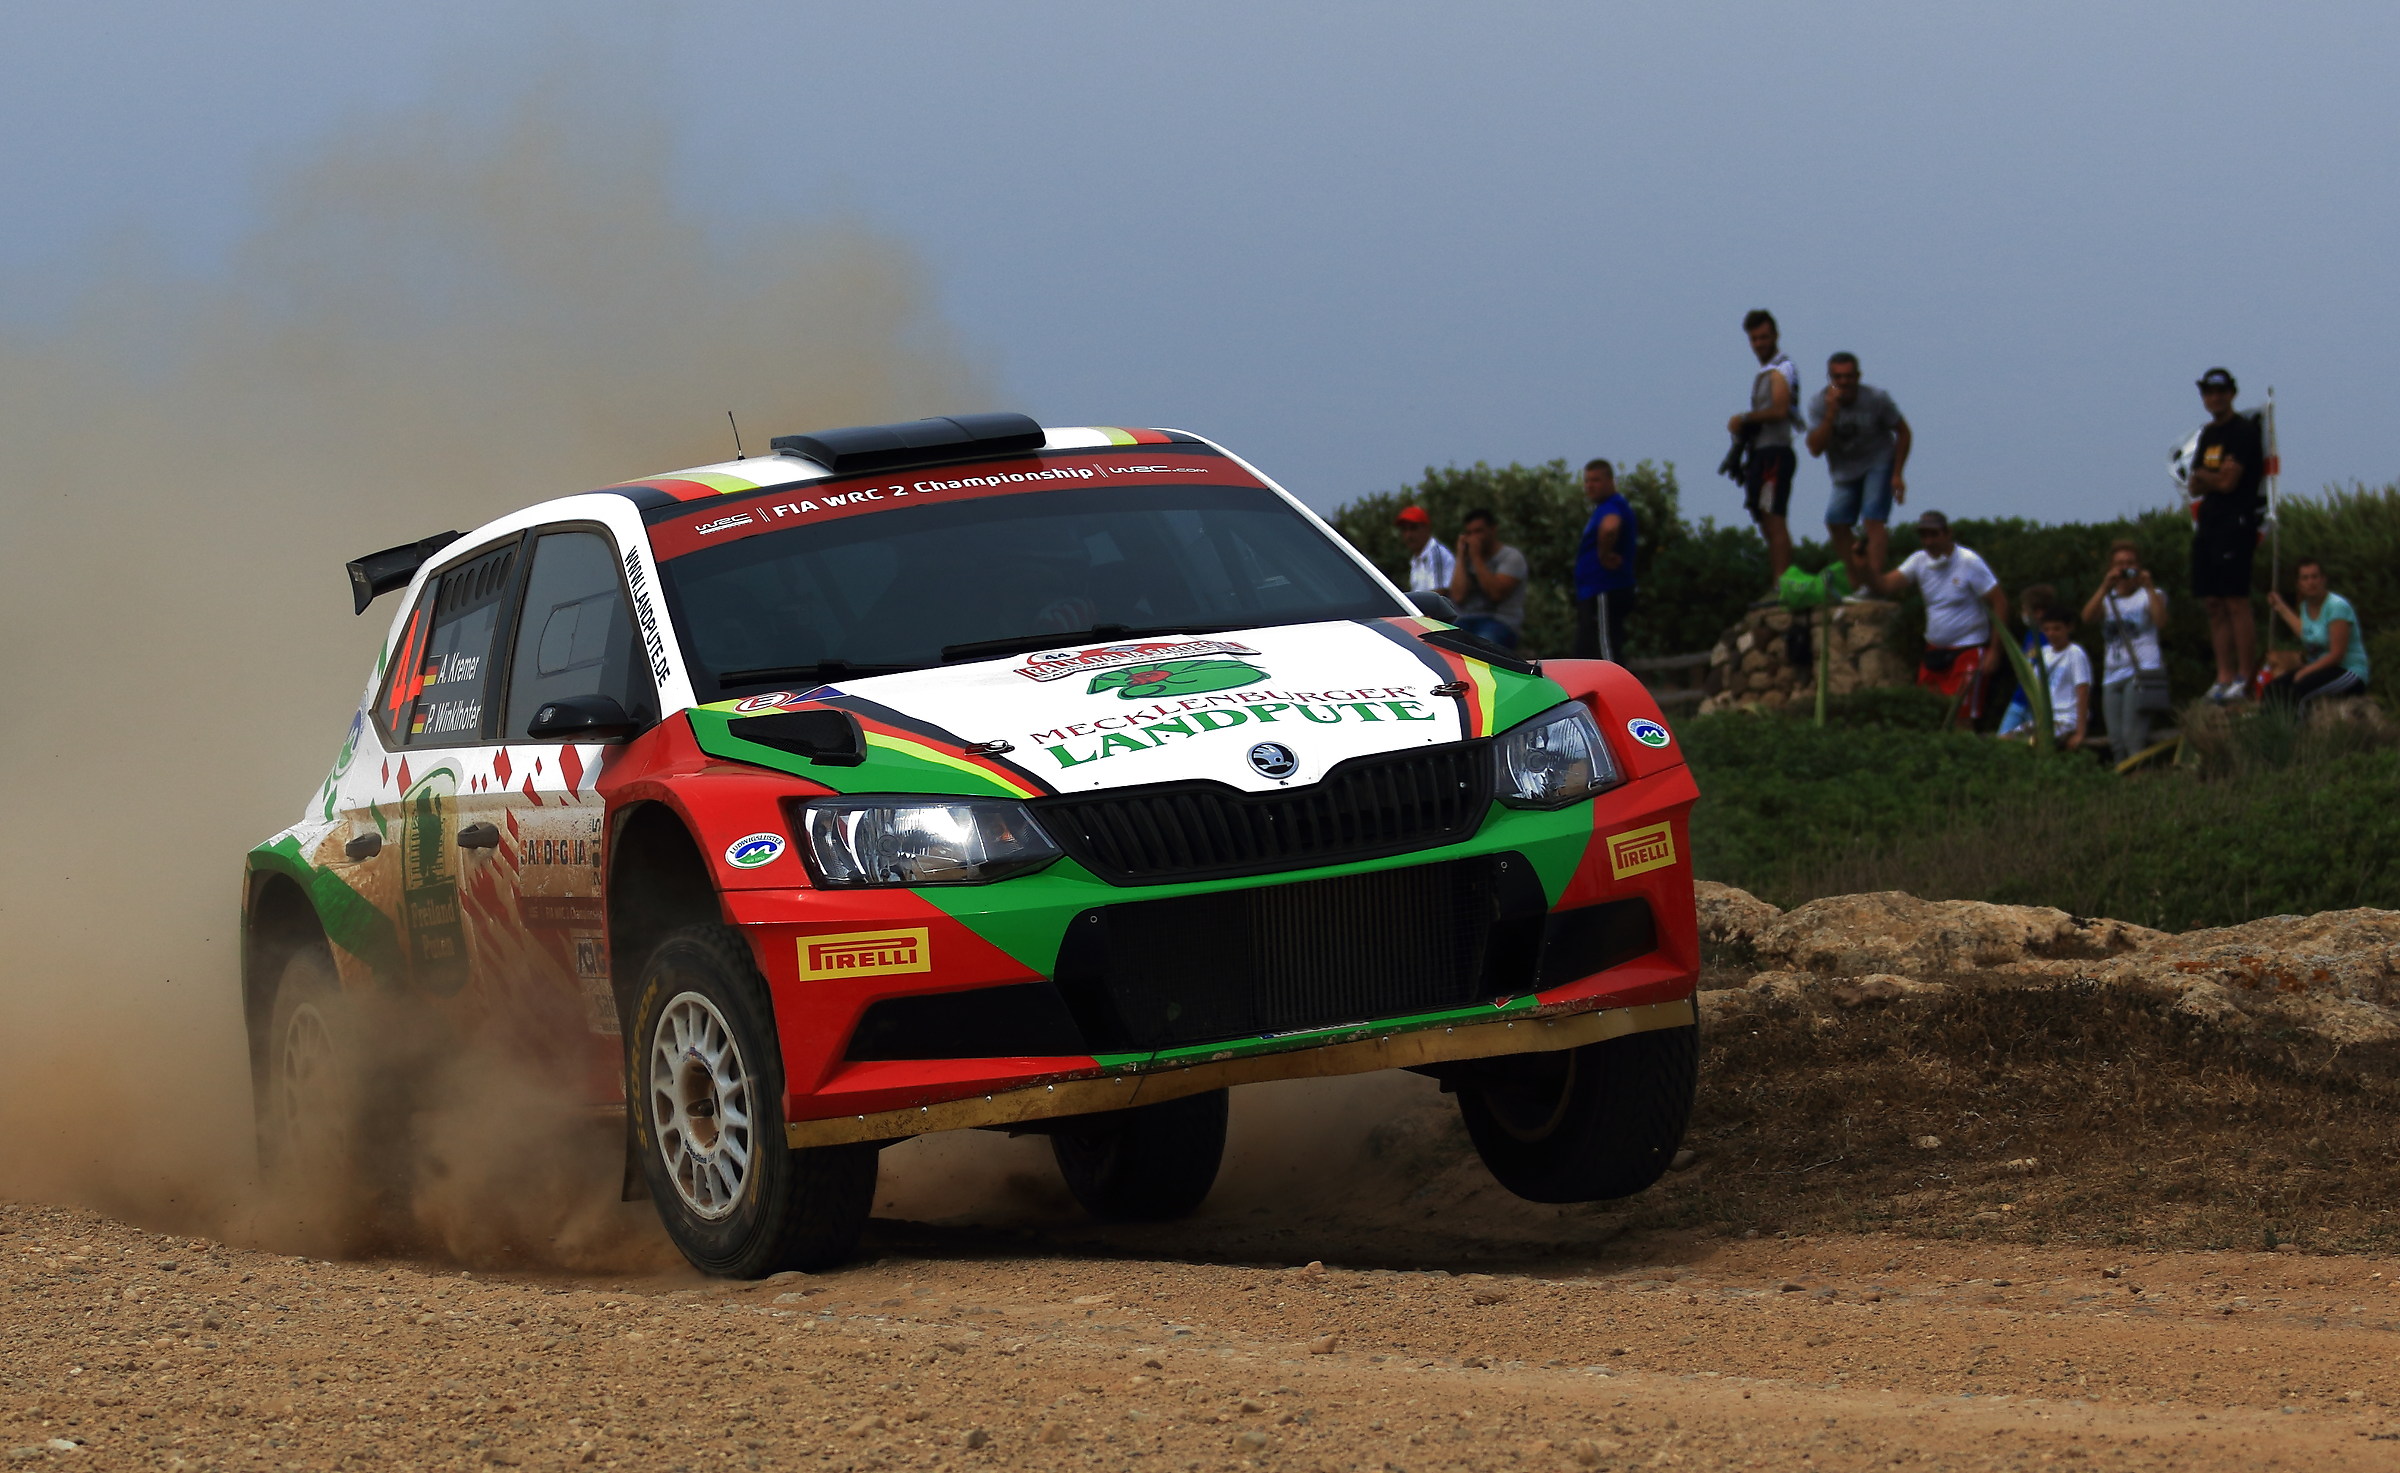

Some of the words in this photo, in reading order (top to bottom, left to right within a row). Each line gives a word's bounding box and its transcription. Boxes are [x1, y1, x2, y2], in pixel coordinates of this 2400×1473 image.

[694, 512, 751, 531] WRC
[772, 499, 819, 518] FIA
[821, 488, 884, 508] WRC
[888, 485, 908, 497] 2
[913, 466, 1095, 493] Championship
[624, 545, 671, 688] WWW.LANDPUTE.DE
[437, 654, 447, 684] A.
[448, 652, 480, 683] Kremer
[1025, 658, 1084, 677] RALLY
[1083, 651, 1144, 665] ITALIA
[1045, 652, 1071, 660] 44
[424, 703, 436, 734] P.
[435, 699, 482, 733] Winklhofer
[1030, 687, 1416, 744] MECKLENBURGER
[1044, 700, 1435, 769] LANDPUTE
[520, 839, 587, 865] SARDEGNA
[1613, 830, 1669, 870] PIRELLI
[808, 936, 918, 972] PIRELLI
